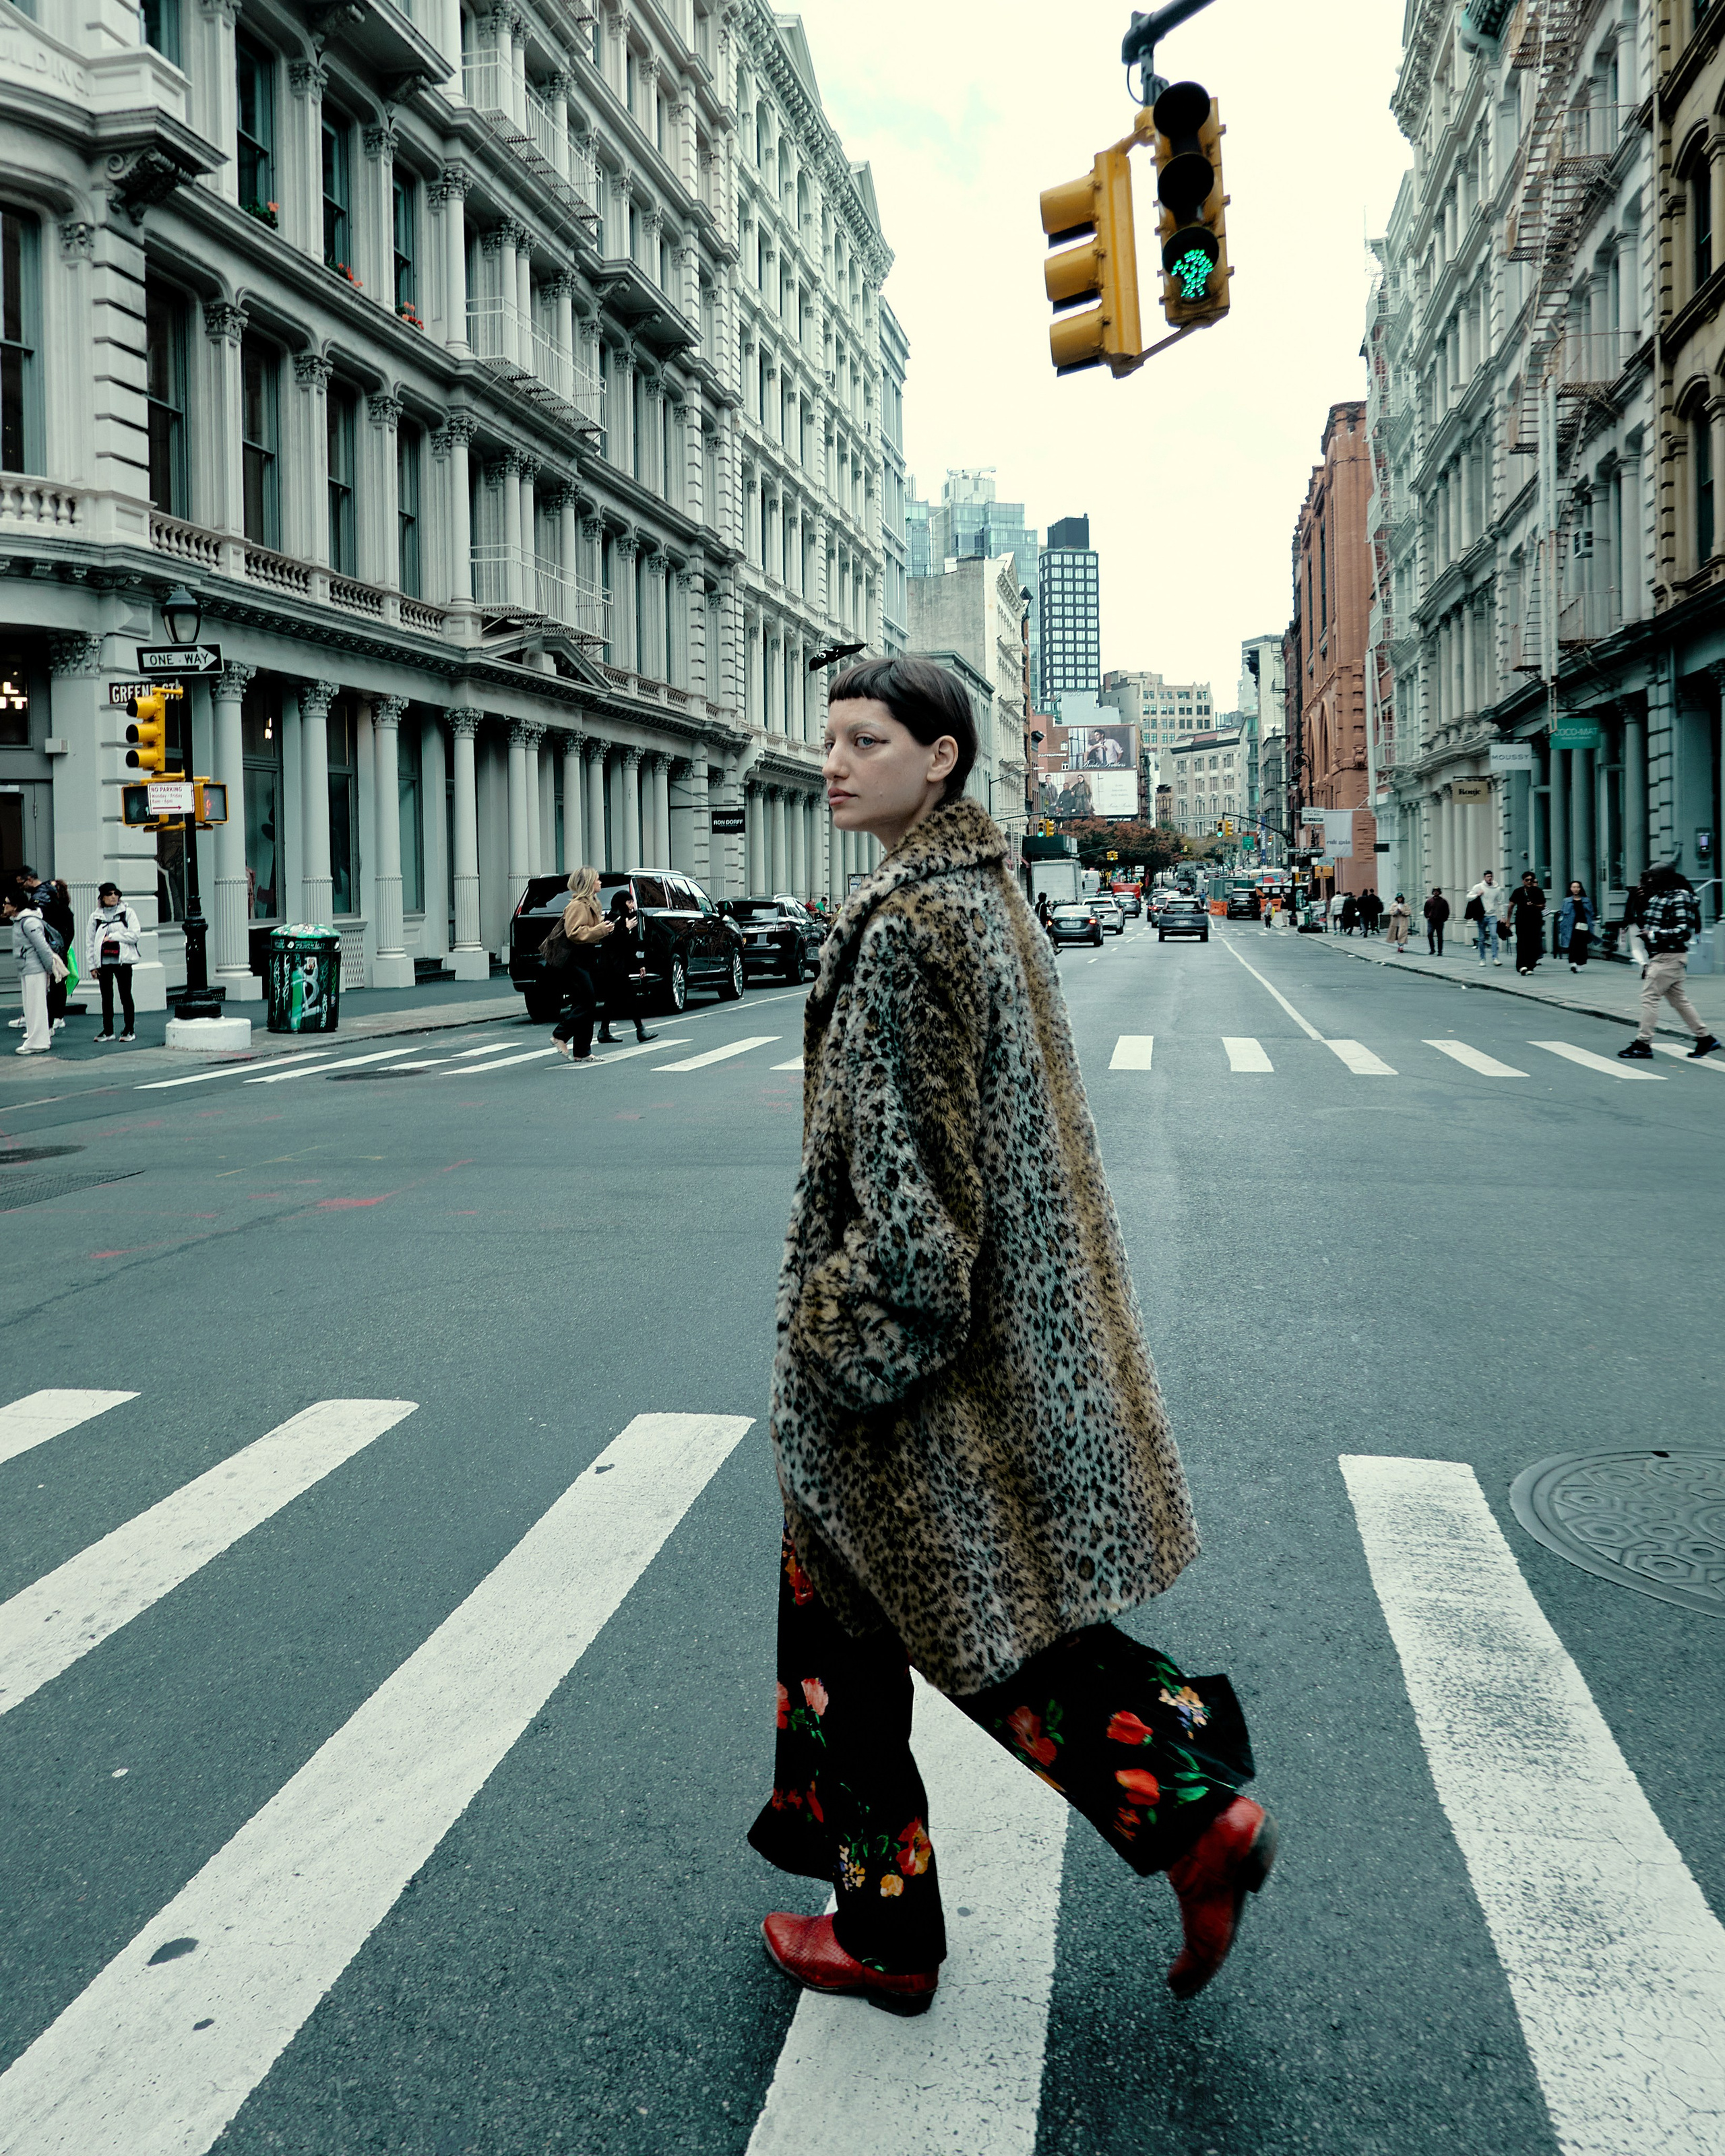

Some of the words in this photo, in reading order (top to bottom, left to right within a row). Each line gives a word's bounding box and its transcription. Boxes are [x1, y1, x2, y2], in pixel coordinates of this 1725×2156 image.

[150, 654, 174, 666] ONE
[185, 653, 209, 664] WAY
[162, 683, 175, 701] ST
